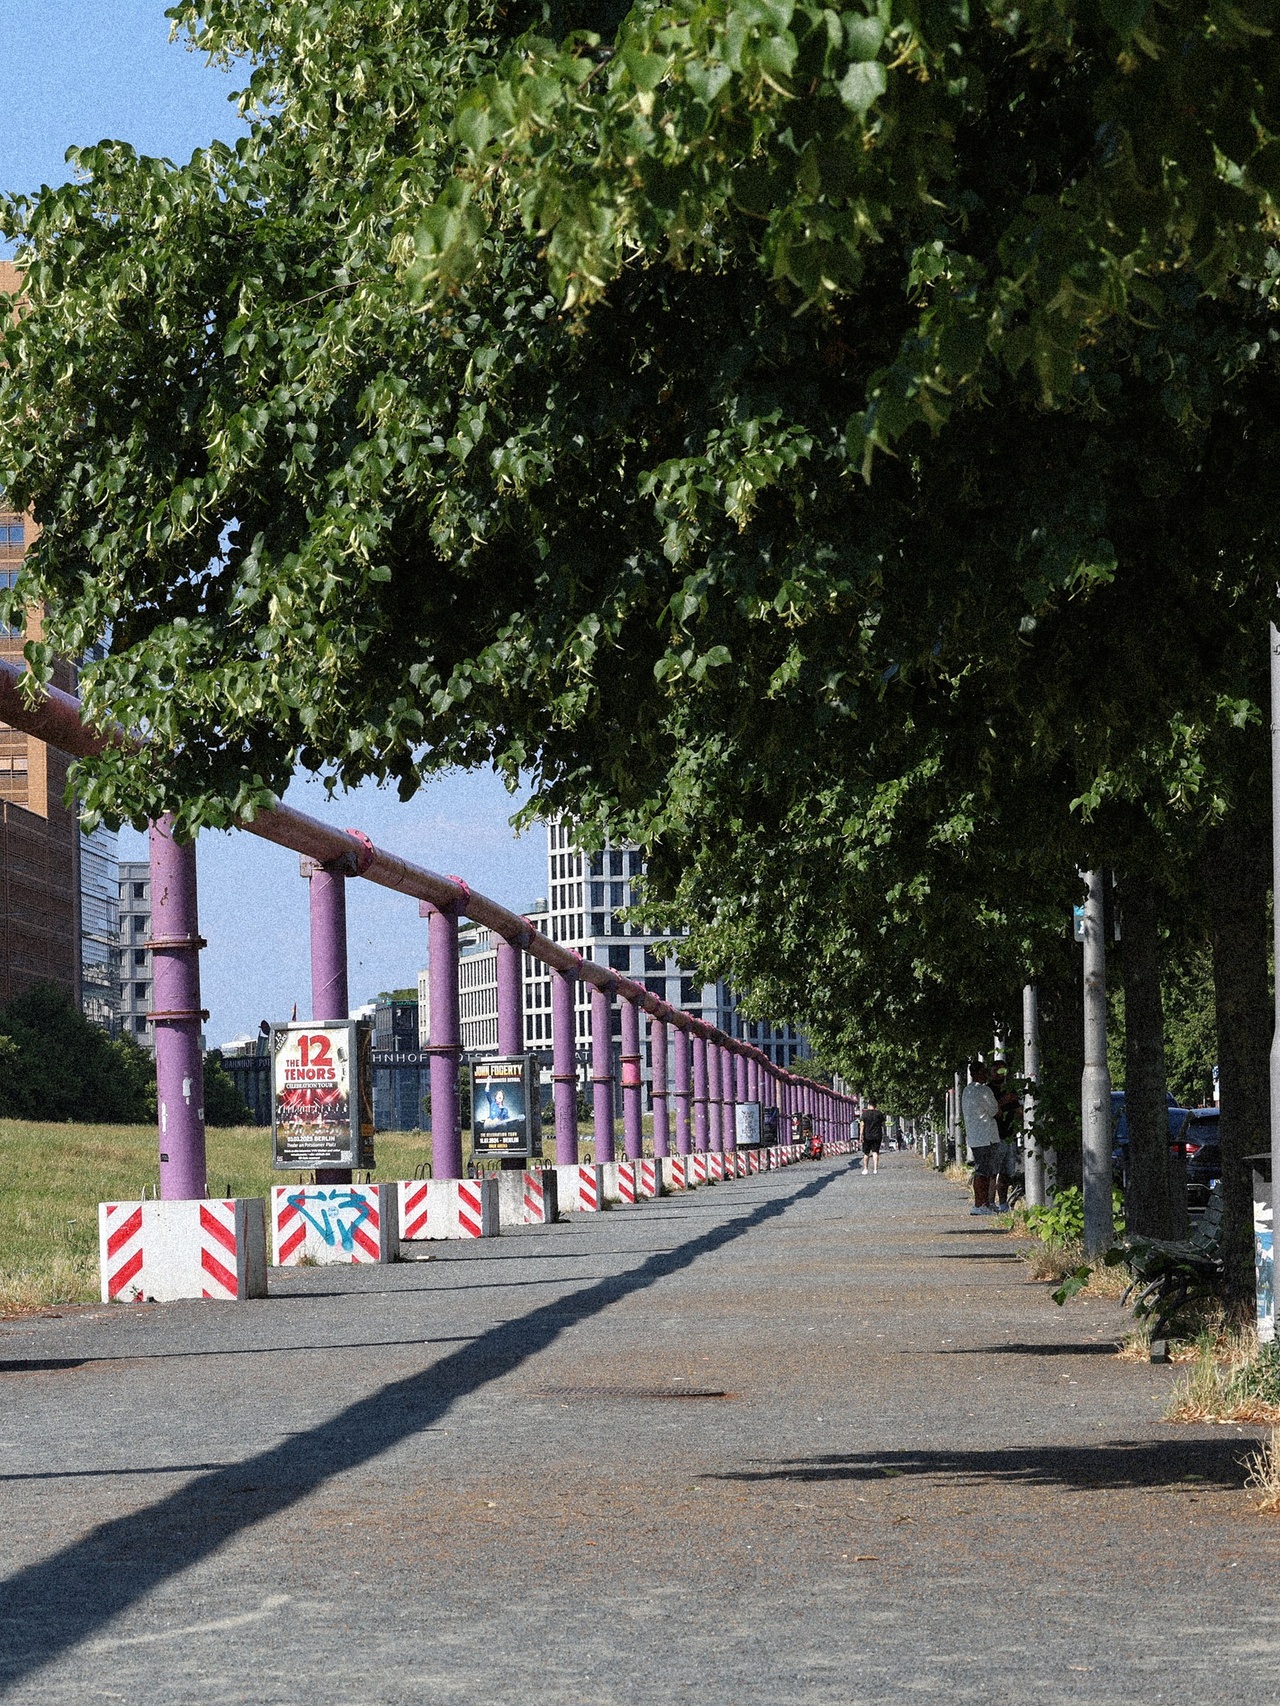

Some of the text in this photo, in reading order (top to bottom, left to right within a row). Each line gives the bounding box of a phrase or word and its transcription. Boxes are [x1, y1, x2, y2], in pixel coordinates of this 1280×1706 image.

[286, 1059, 299, 1067] THE
[297, 1035, 333, 1067] 12
[284, 1068, 336, 1081] TENORS
[474, 1064, 523, 1076] JOHN FOGERTY
